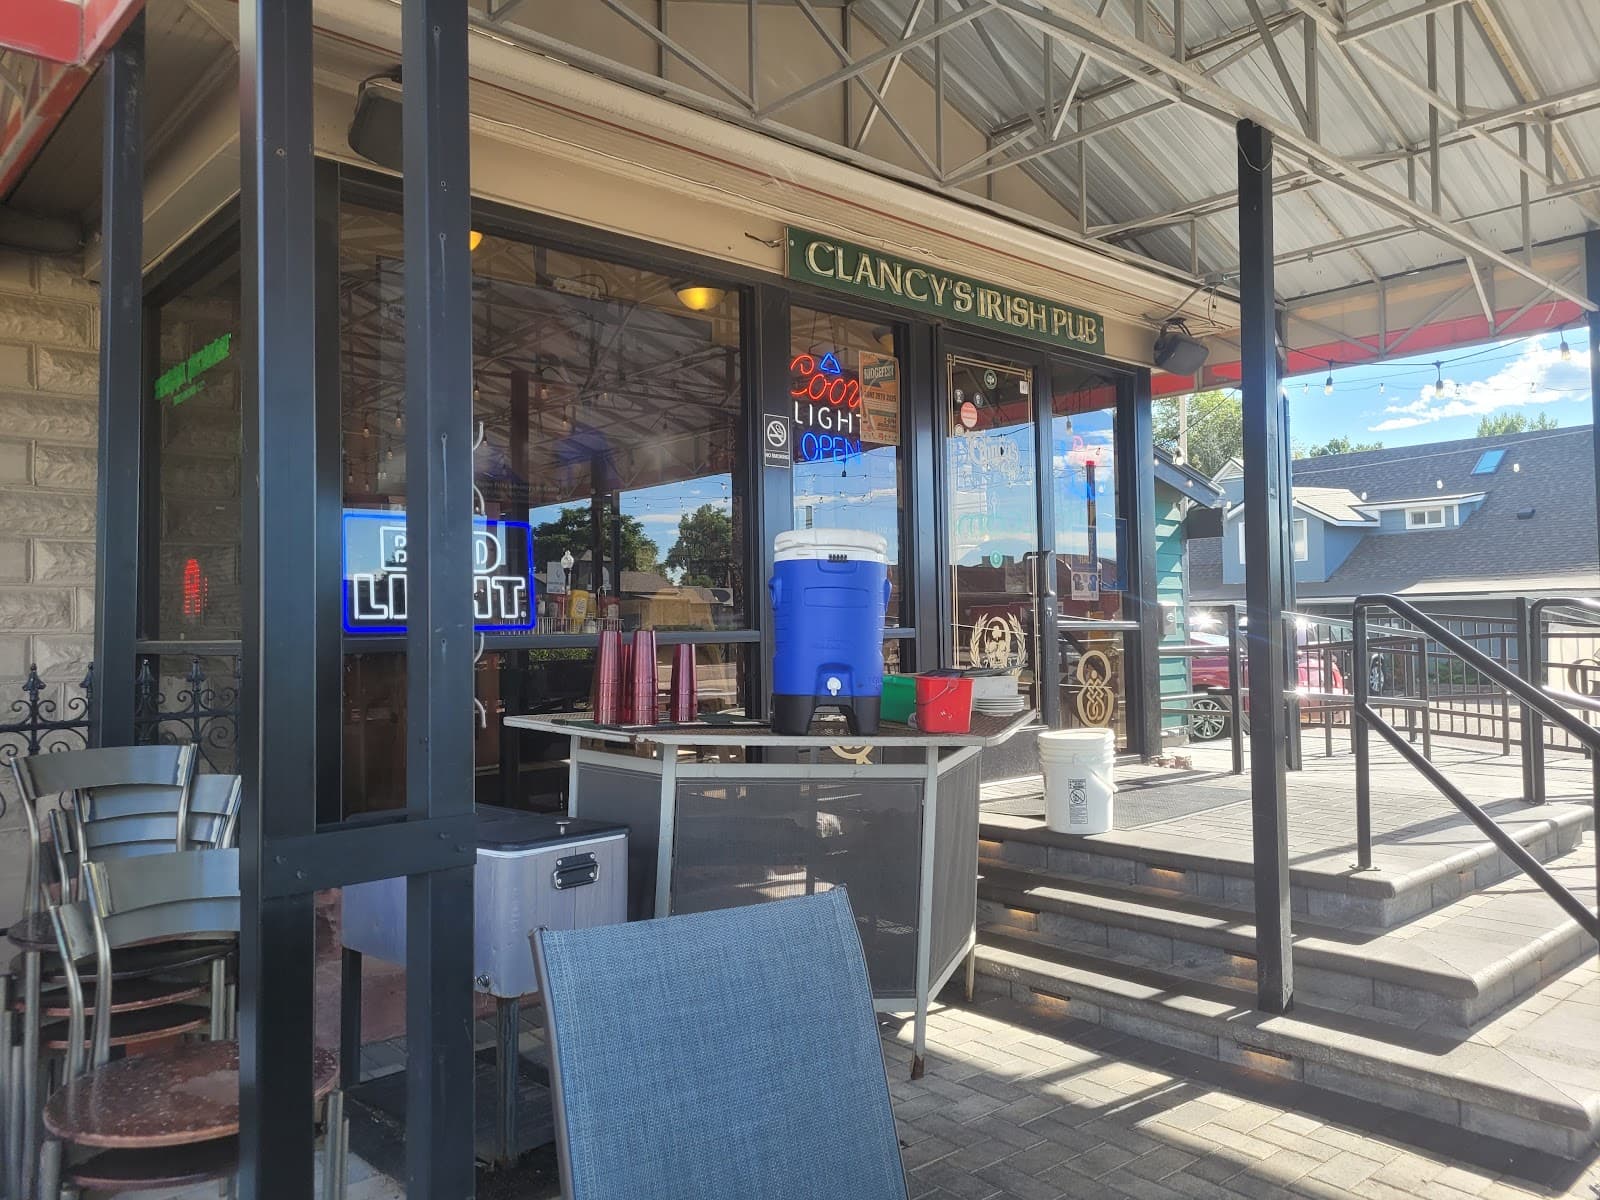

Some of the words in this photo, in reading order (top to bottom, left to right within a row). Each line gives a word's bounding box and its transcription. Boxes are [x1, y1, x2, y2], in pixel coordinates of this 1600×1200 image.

[805, 241, 972, 313] CLANCY'S
[976, 287, 1047, 332] IRISH
[1052, 307, 1098, 345] PUB
[790, 354, 861, 408] Coor
[802, 432, 861, 464] OPEN
[380, 526, 501, 574] BD
